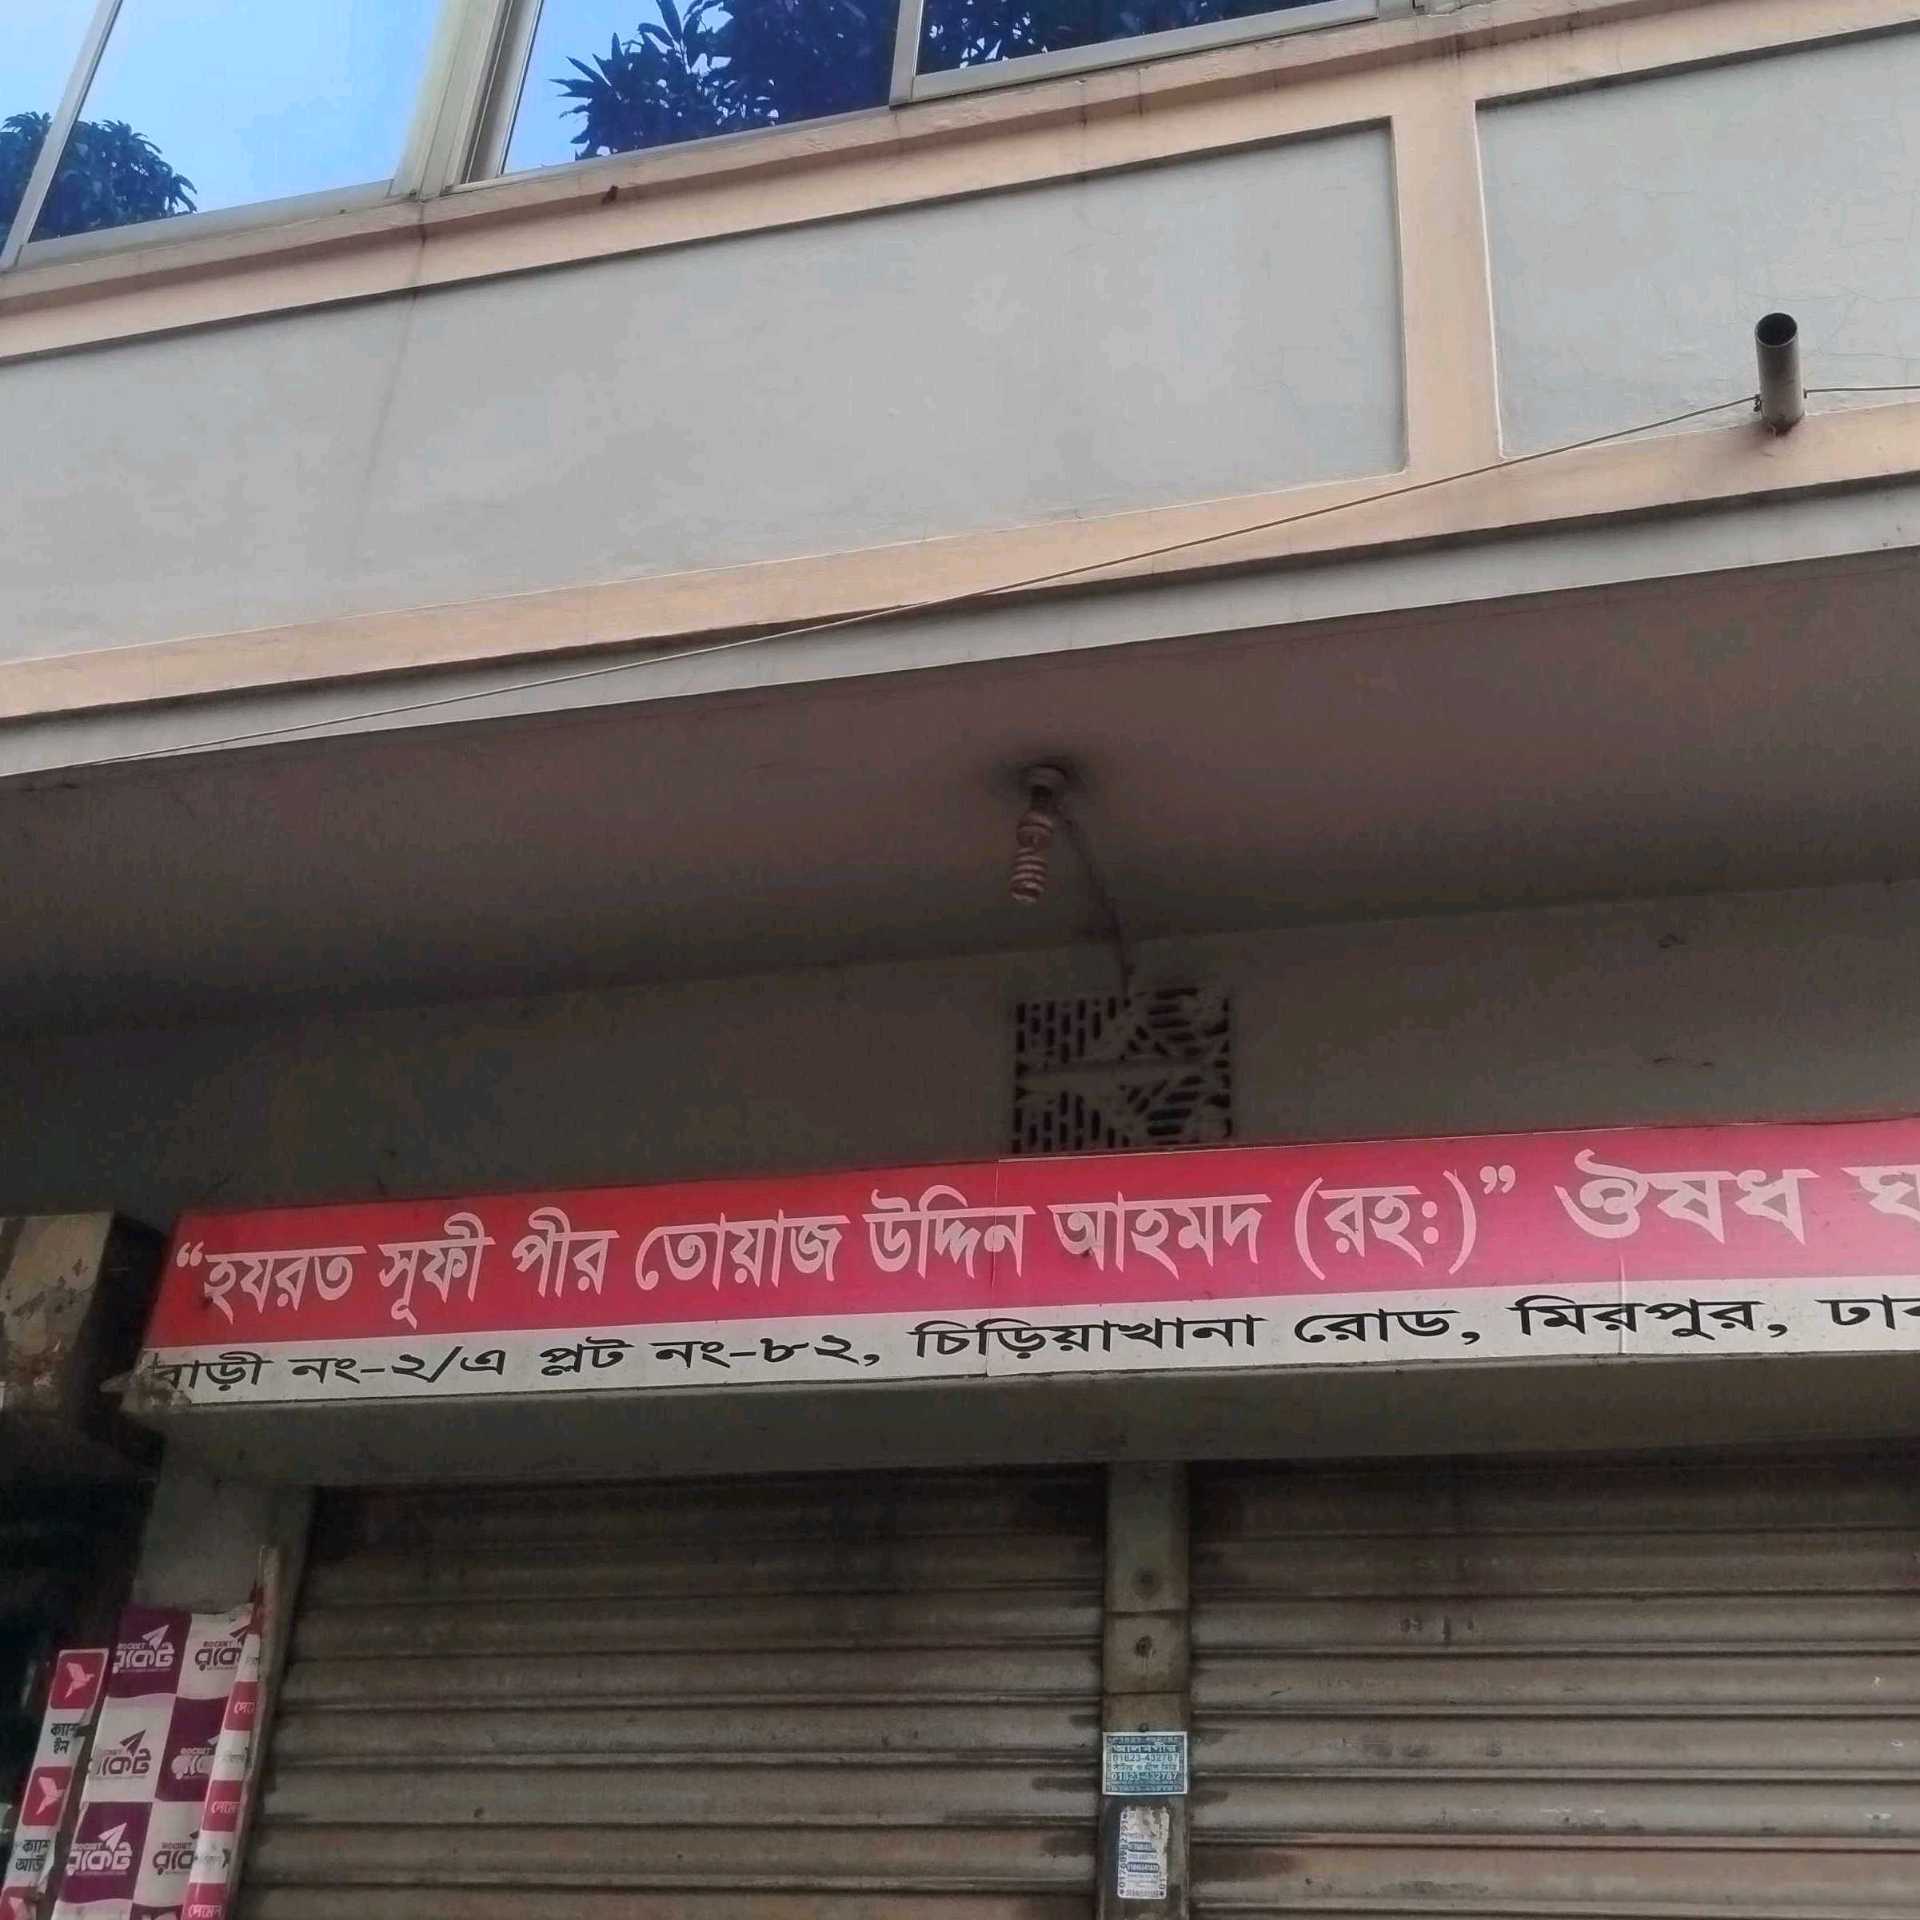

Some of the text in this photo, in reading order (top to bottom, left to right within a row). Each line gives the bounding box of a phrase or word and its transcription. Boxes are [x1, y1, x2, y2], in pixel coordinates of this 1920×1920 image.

[378, 1212, 495, 1329] সূফী
[512, 1207, 620, 1298] পীর
[635, 1209, 850, 1291] তোয়াজ
[862, 1185, 1036, 1278] উদ্দিন
[1048, 1191, 1272, 1281] আহমদ
[1554, 1149, 1820, 1245] ঔষধ
[539, 1336, 635, 1376] প্লট
[906, 1314, 1269, 1359] চিড়িয়াখানা
[1294, 1309, 1480, 1346] রোড,
[1505, 1294, 1788, 1340] মিরপুর,
